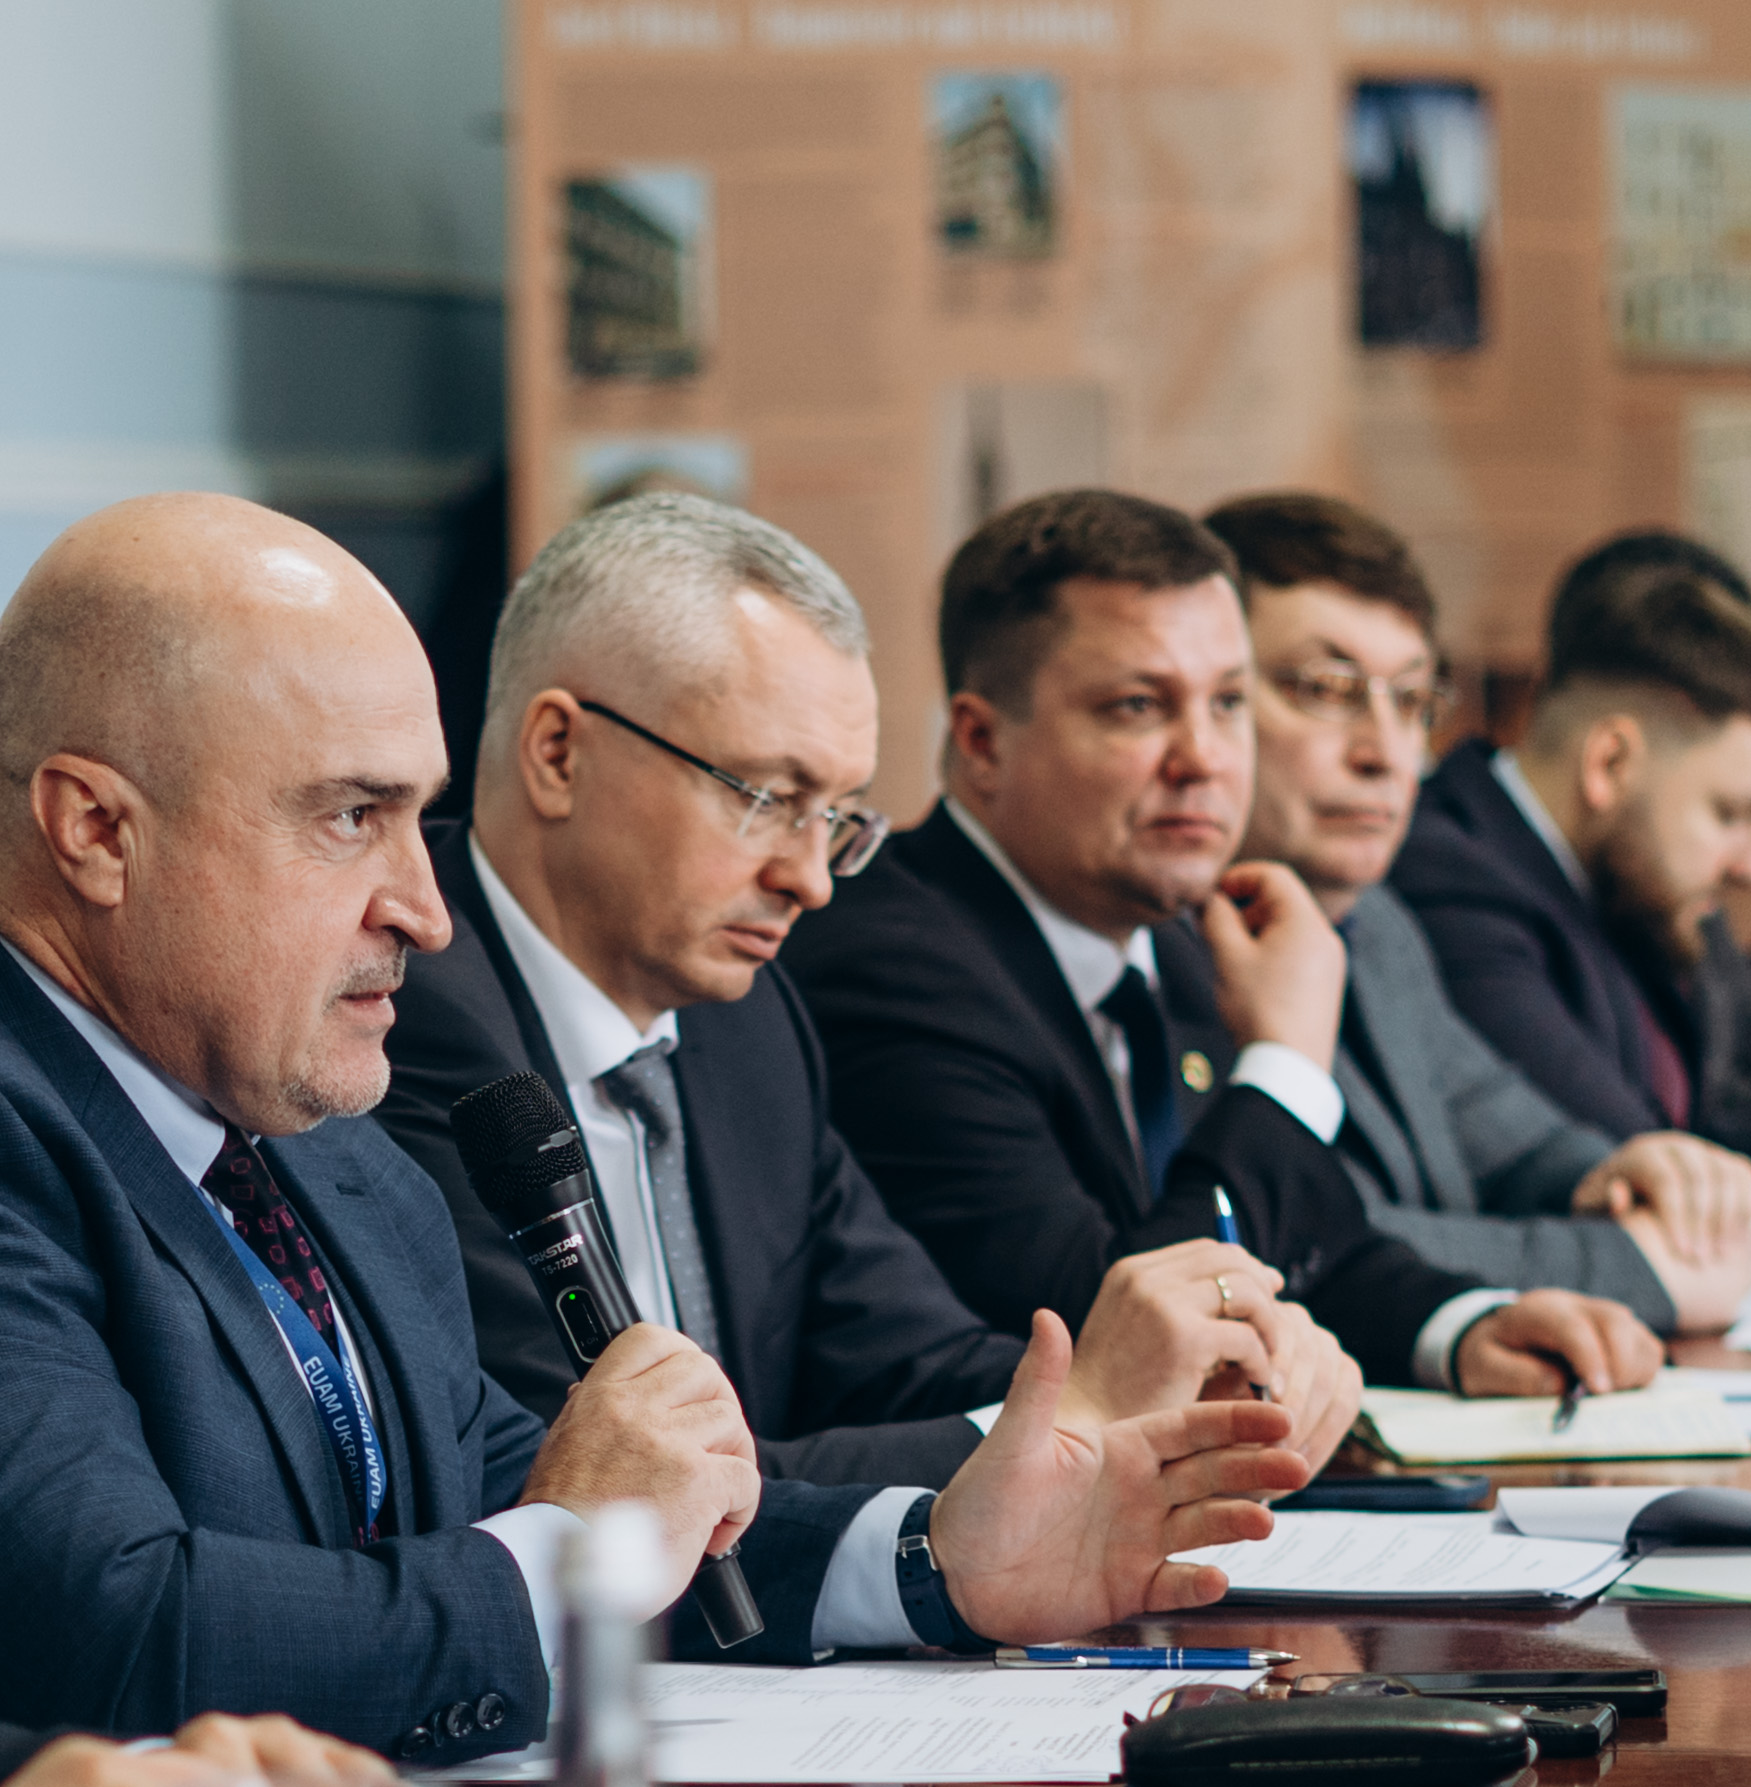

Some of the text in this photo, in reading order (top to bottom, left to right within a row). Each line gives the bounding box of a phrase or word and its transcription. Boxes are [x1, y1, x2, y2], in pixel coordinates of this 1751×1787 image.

[527, 1234, 584, 1265] TAKSTAR
[541, 1253, 579, 1276] TS-7220
[303, 1356, 364, 1502] EUAM UKRAIN
[365, 1448, 382, 1509] EUAM
